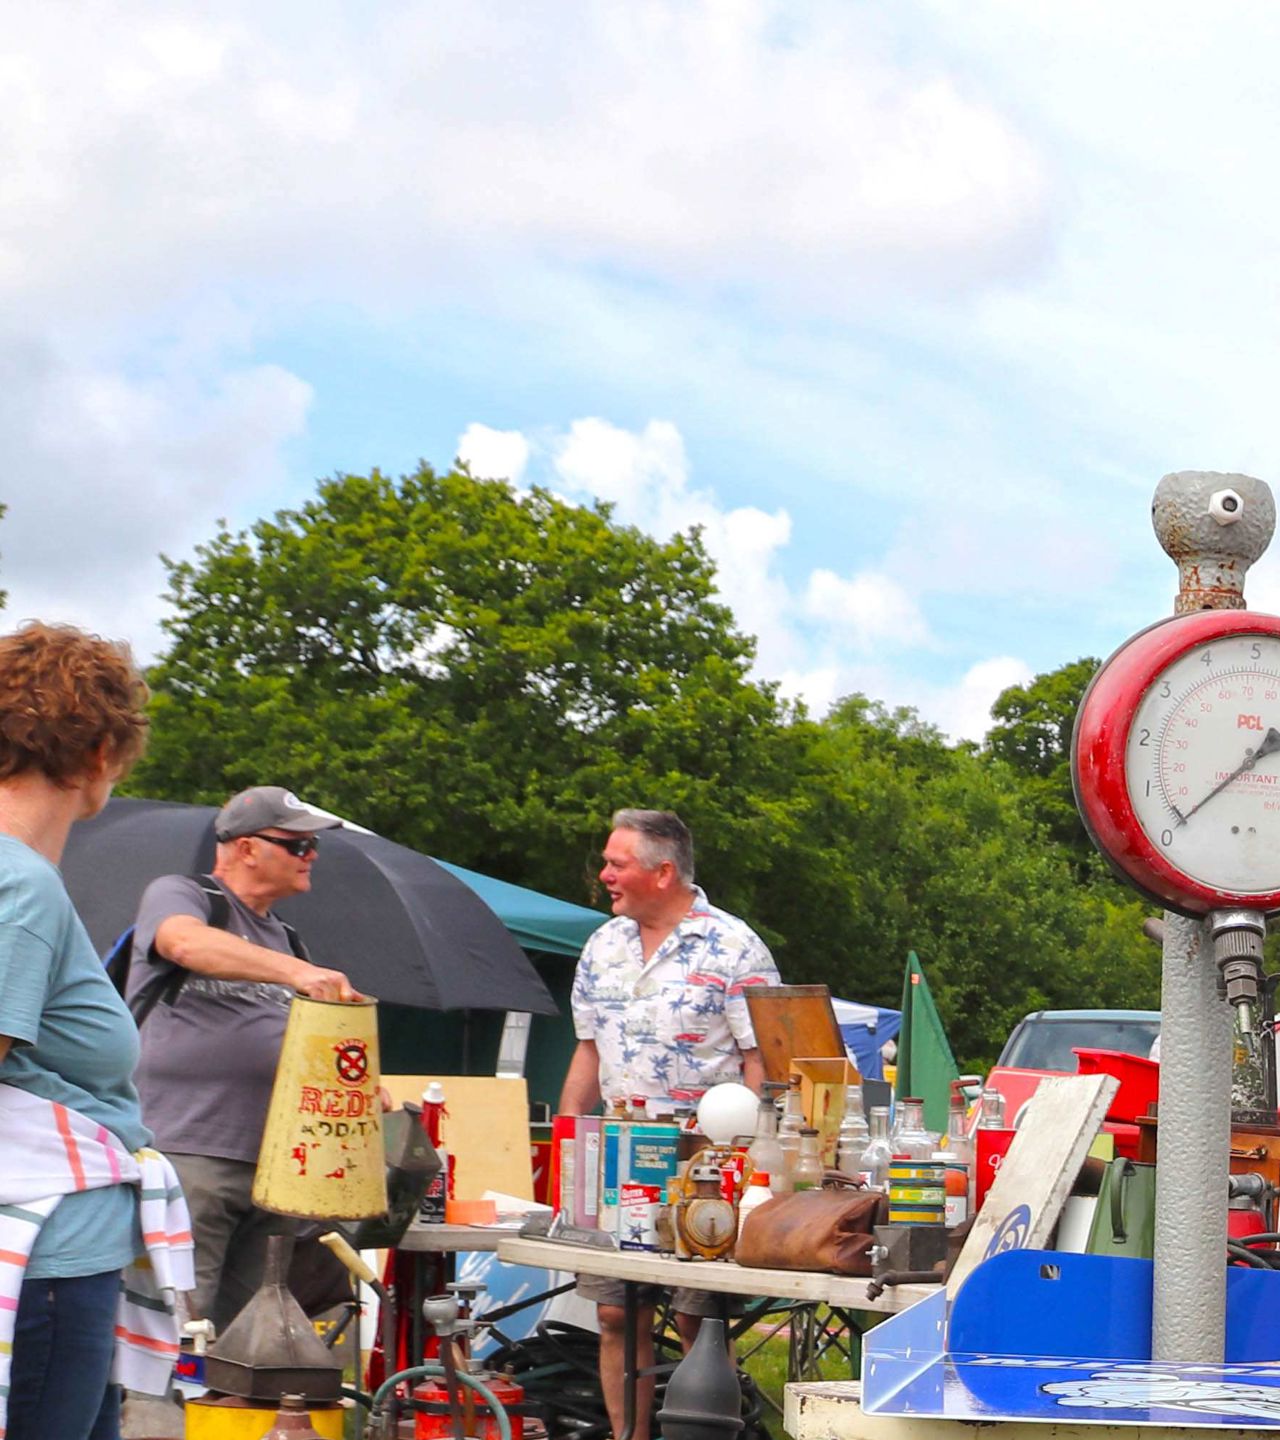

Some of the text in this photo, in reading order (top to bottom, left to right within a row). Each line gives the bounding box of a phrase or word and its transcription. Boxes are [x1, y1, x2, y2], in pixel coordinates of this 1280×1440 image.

[1140, 729, 1151, 746] 2
[1160, 681, 1171, 698] 3
[1201, 650, 1212, 666] 4
[1250, 644, 1261, 660] 5
[1242, 686, 1253, 697] 70
[1264, 690, 1277, 701] 80
[1185, 718, 1198, 729] 40
[1237, 714, 1264, 731] PCL
[1176, 739, 1188, 750] 30
[1173, 762, 1186, 773] 20
[1215, 771, 1278, 785] IMPORTANT
